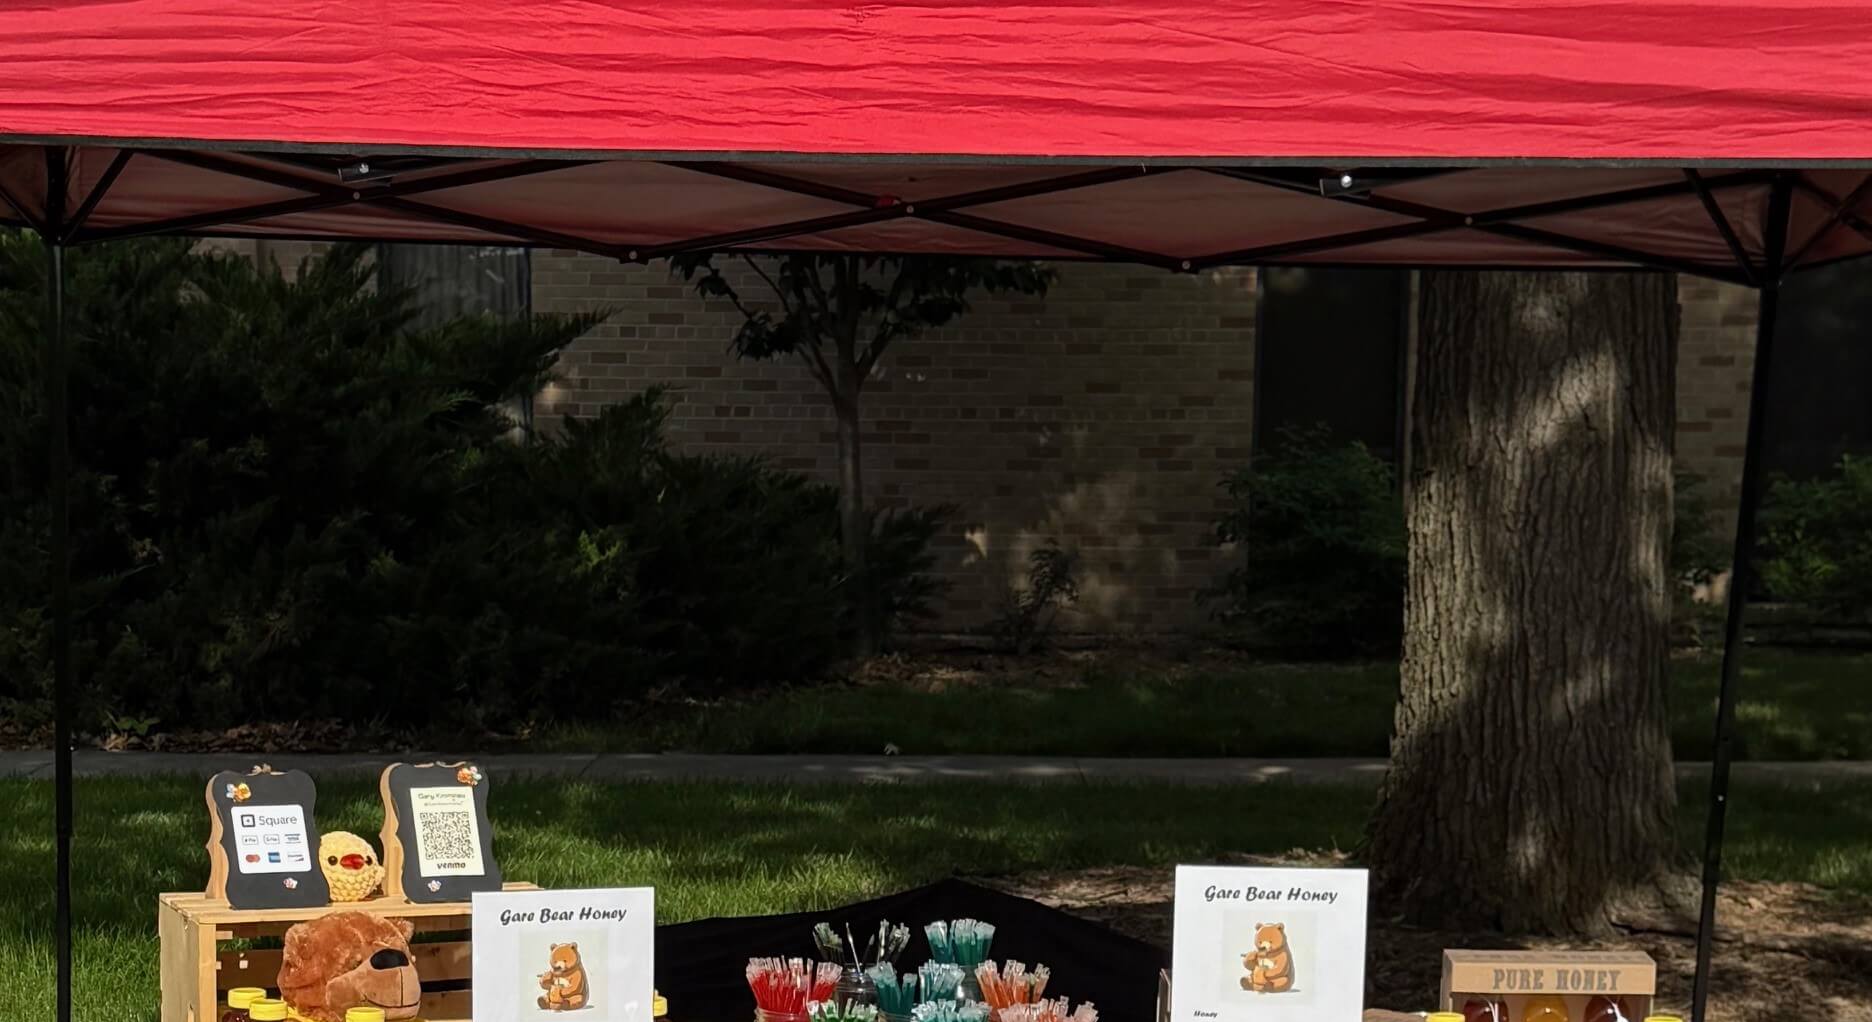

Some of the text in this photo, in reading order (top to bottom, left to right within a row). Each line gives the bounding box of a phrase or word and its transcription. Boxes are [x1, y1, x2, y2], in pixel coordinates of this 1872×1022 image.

[258, 816, 298, 827] Square
[1204, 885, 1338, 904] Gare Bear Honey
[500, 906, 627, 926] Gare Bear Honey
[1492, 968, 1621, 991] PURE HONEY
[1194, 1010, 1218, 1018] Honey
